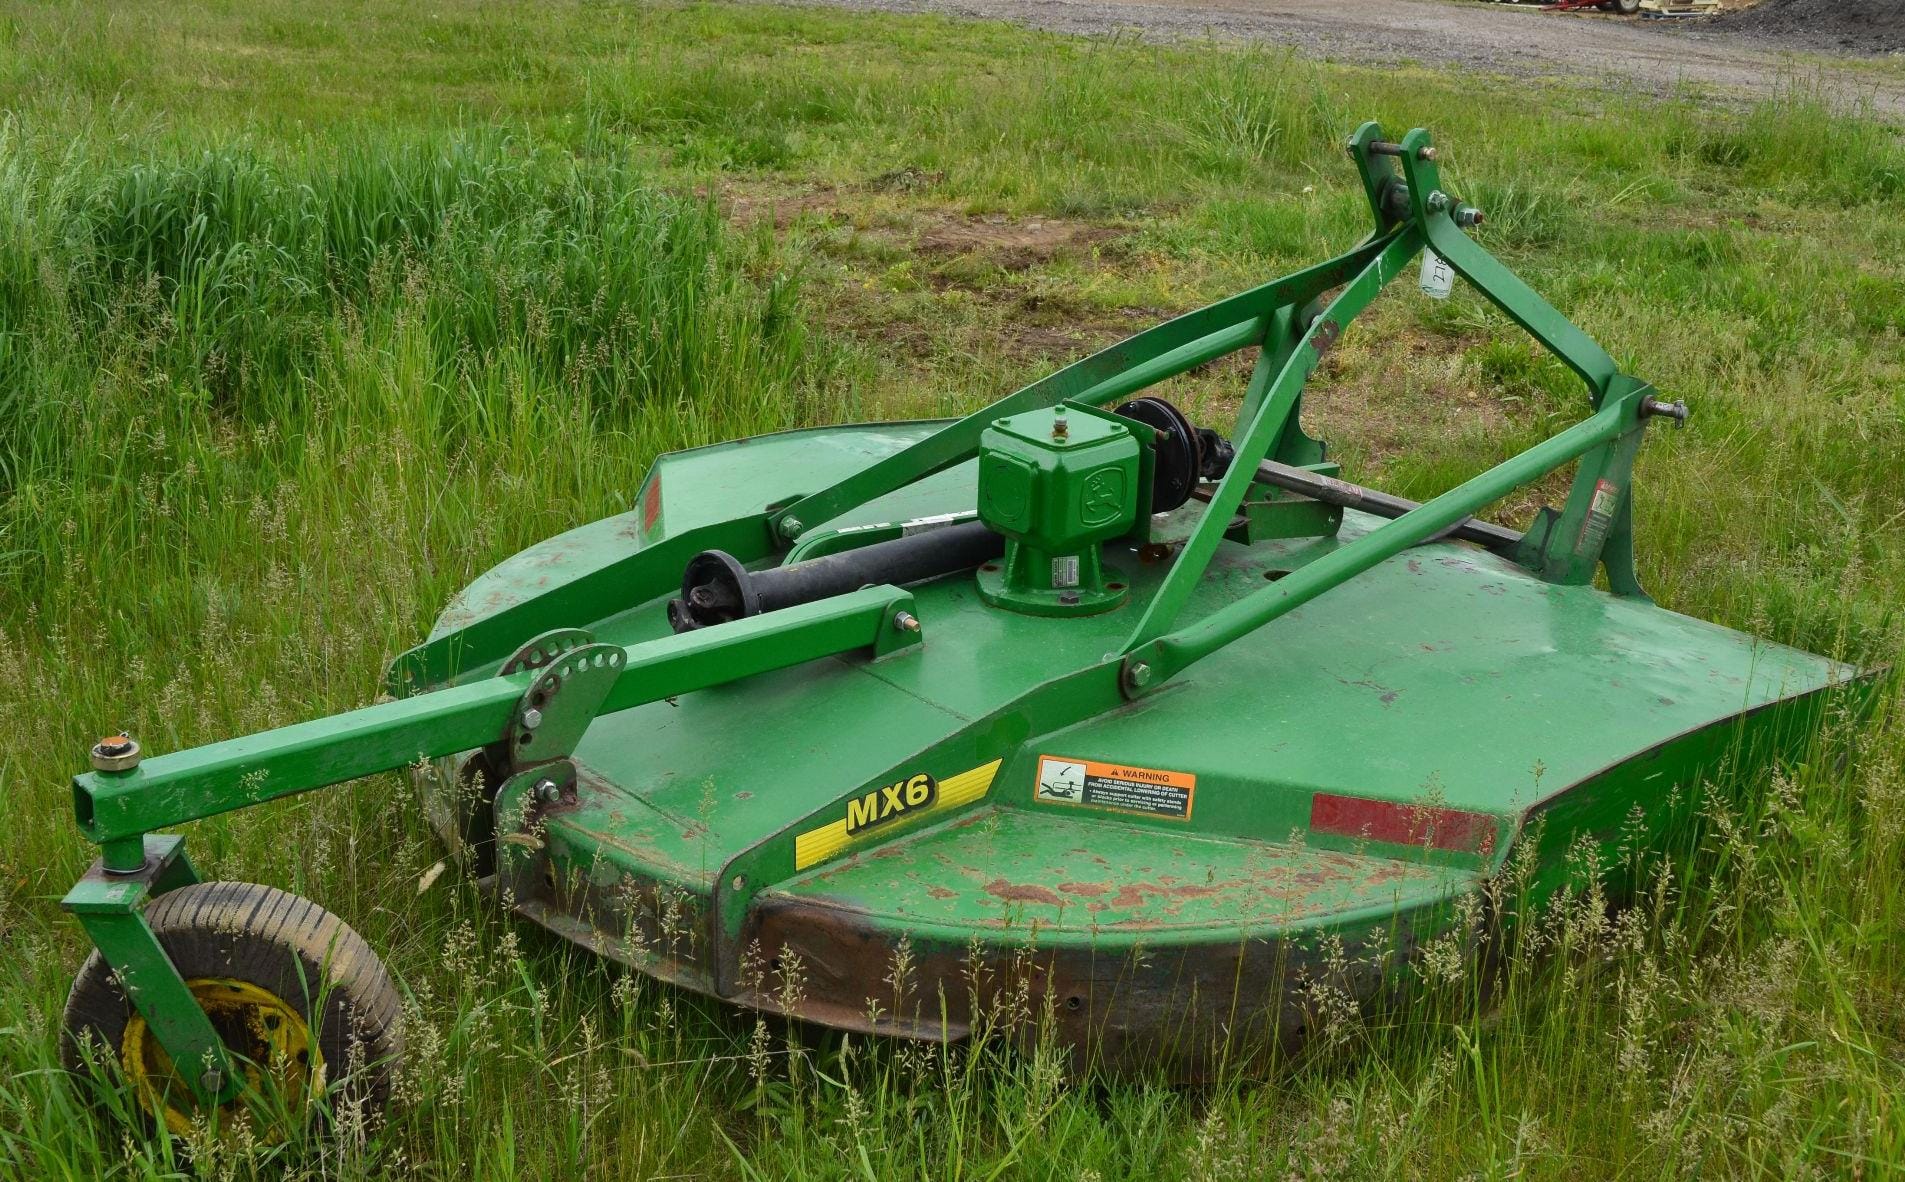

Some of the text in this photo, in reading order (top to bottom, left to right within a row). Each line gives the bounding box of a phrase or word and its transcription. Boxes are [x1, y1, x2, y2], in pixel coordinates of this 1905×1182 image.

[1122, 769, 1170, 782] WARNING
[1103, 784, 1133, 792] ACCIDENTAL
[1134, 787, 1160, 796] LOWERING
[1168, 792, 1188, 800] CUTTER
[847, 773, 930, 831] MX6
